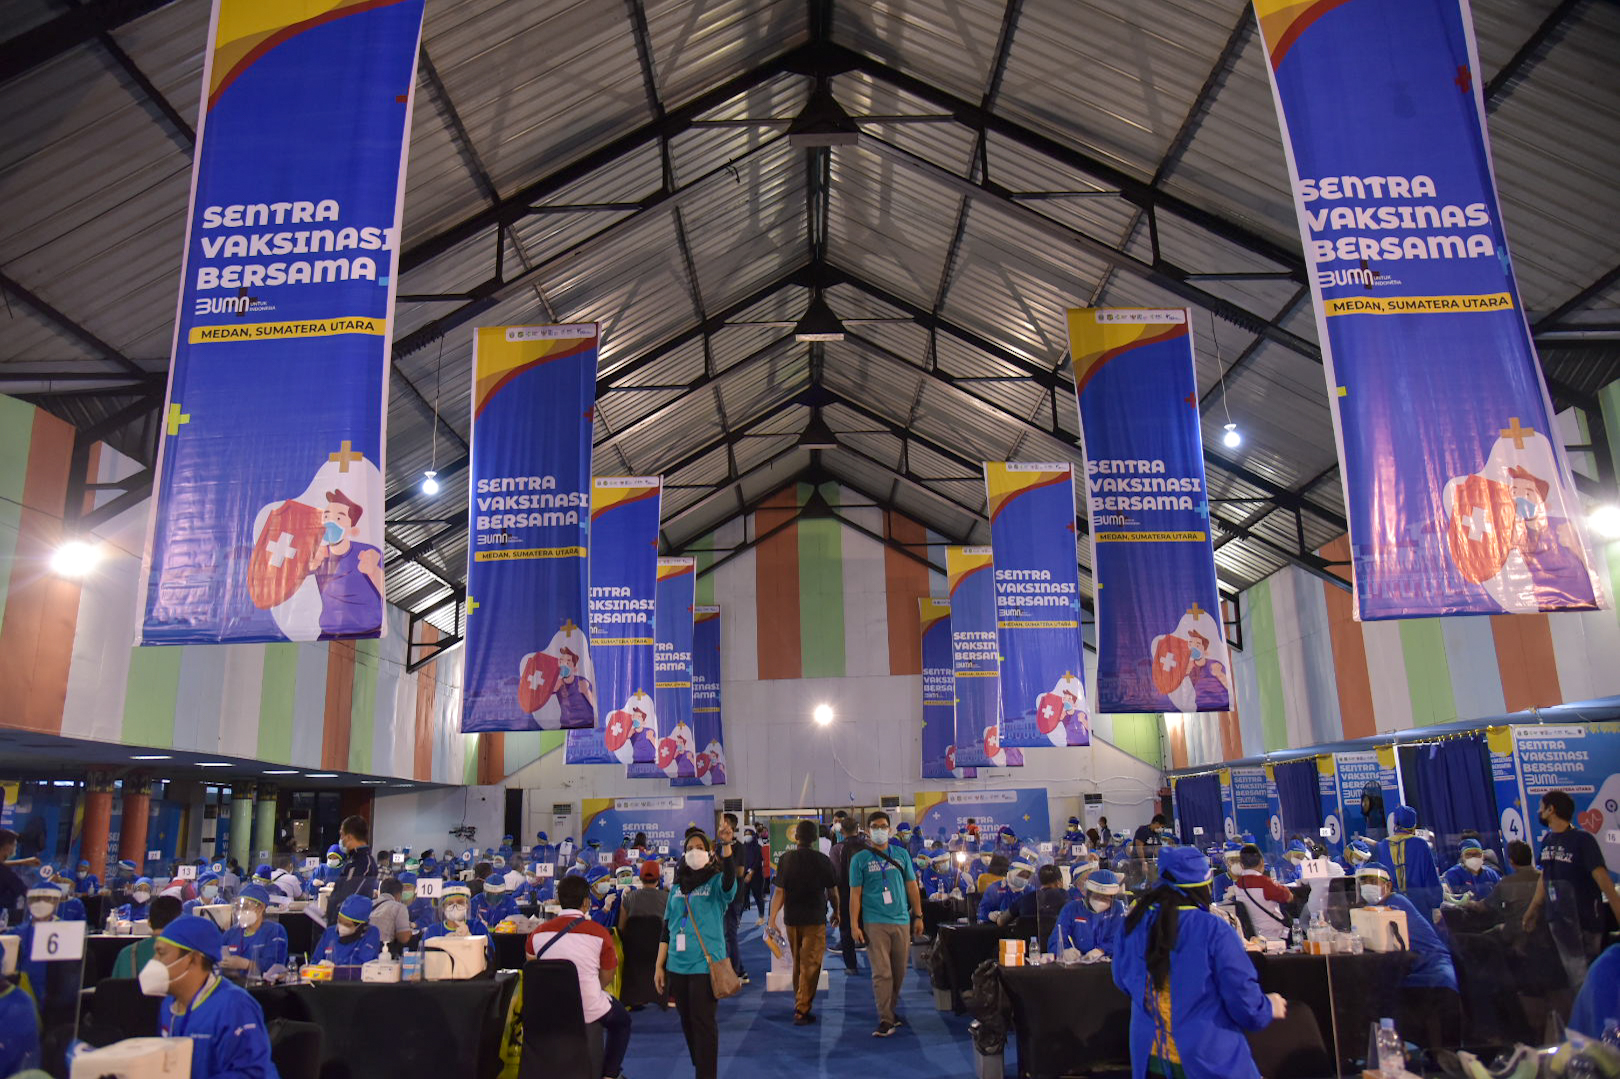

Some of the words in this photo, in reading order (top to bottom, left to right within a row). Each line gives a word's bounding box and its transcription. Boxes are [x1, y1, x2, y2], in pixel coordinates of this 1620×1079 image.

[1300, 175, 1436, 202] SENTRA
[202, 199, 340, 228] SENTRA
[1306, 202, 1491, 232] VAKSINAS
[201, 227, 394, 258] VAKSINASI
[1312, 234, 1494, 263] BERSAMA
[197, 257, 376, 290] BERSAMA
[1334, 300, 1384, 312] MEDAN,
[1388, 299, 1459, 311] SUMATERA
[1462, 296, 1508, 308] UTARA
[201, 328, 252, 340] MEDAN,
[256, 323, 326, 336] SUMATERA
[330, 320, 375, 332] UTARA
[1088, 460, 1166, 474] SENTRA
[477, 476, 556, 494] SENTRA
[1089, 478, 1202, 492] VAKSINASI
[478, 492, 588, 512] VAKSINASI
[1092, 496, 1192, 512] BERSAMA
[476, 511, 578, 530] BERSAMA
[512, 550, 552, 558] SUMATERA
[555, 548, 579, 556] UTARA
[996, 570, 1050, 580] SENTRA
[996, 582, 1076, 593] VAKSINASI
[590, 599, 654, 610] AKSINASI
[998, 596, 1070, 606] BERSAMA
[590, 612, 646, 624] ERSAMA
[954, 632, 996, 640] SENTRA
[954, 642, 997, 650] VAKSIN
[1518, 740, 1566, 750] SENTRA
[1521, 751, 1589, 761] VAKSINASI
[1340, 764, 1376, 772] SENTRA
[1524, 762, 1584, 772] BERSAMA
[622, 822, 658, 830] SENTRA
[1228, 824, 1232, 834] 2
[1274, 822, 1278, 834] 3
[1330, 823, 1336, 836] 3
[1510, 818, 1518, 836] 4
[182, 868, 192, 876] 13
[538, 865, 548, 873] 14
[1307, 862, 1318, 873] 11
[421, 884, 433, 895] 10
[48, 933, 58, 954] 6
